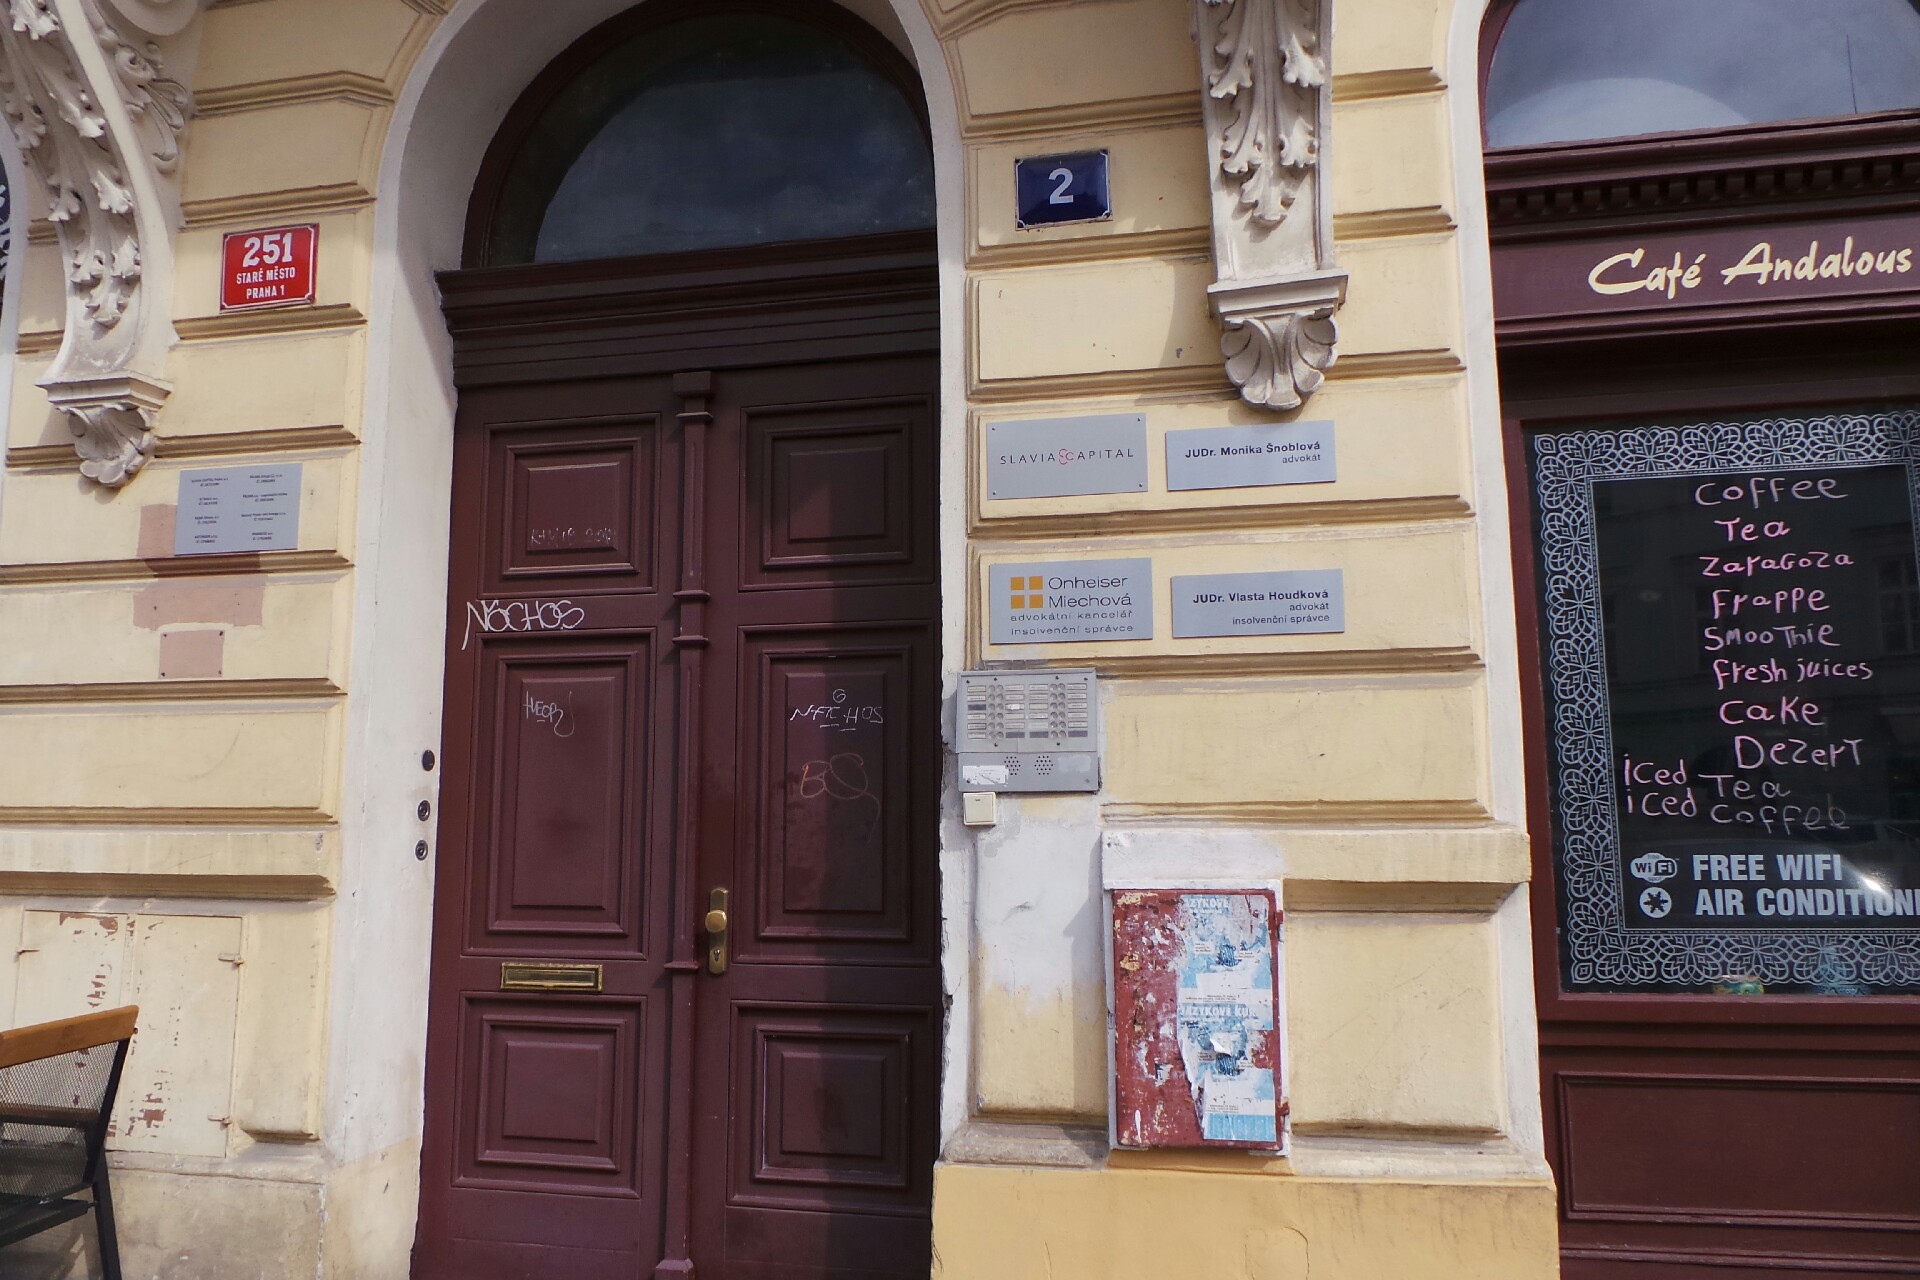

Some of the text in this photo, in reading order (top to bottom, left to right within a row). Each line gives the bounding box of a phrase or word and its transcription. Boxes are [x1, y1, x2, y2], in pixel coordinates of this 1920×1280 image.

[1048, 167, 1074, 205] 2
[242, 232, 293, 268] 251
[236, 265, 296, 285] STARÉ MĚSTO
[1587, 235, 1913, 300] Café Andalous
[246, 284, 285, 299] PRAHA 1
[1000, 448, 1134, 465] SLAVIA CAPITAL
[1185, 441, 1321, 459] JUDr. Monika Šnoblová
[1282, 454, 1321, 464] advokát
[1714, 517, 1791, 542] Tea
[1048, 576, 1128, 590] Onheiser
[1049, 592, 1132, 608] Miechová
[1193, 588, 1329, 604] JUDr. Vlasta Houdková
[1289, 602, 1329, 611] advokát
[1010, 610, 1133, 622] advokátní kancelář
[1232, 613, 1330, 625] insolvenční správce
[1011, 625, 1134, 636] insolvenční správce
[1797, 658, 1873, 683] juices
[1698, 774, 1791, 799] Tea
[1692, 854, 1843, 881] FREE WIFI
[1695, 888, 1745, 916] AIR
